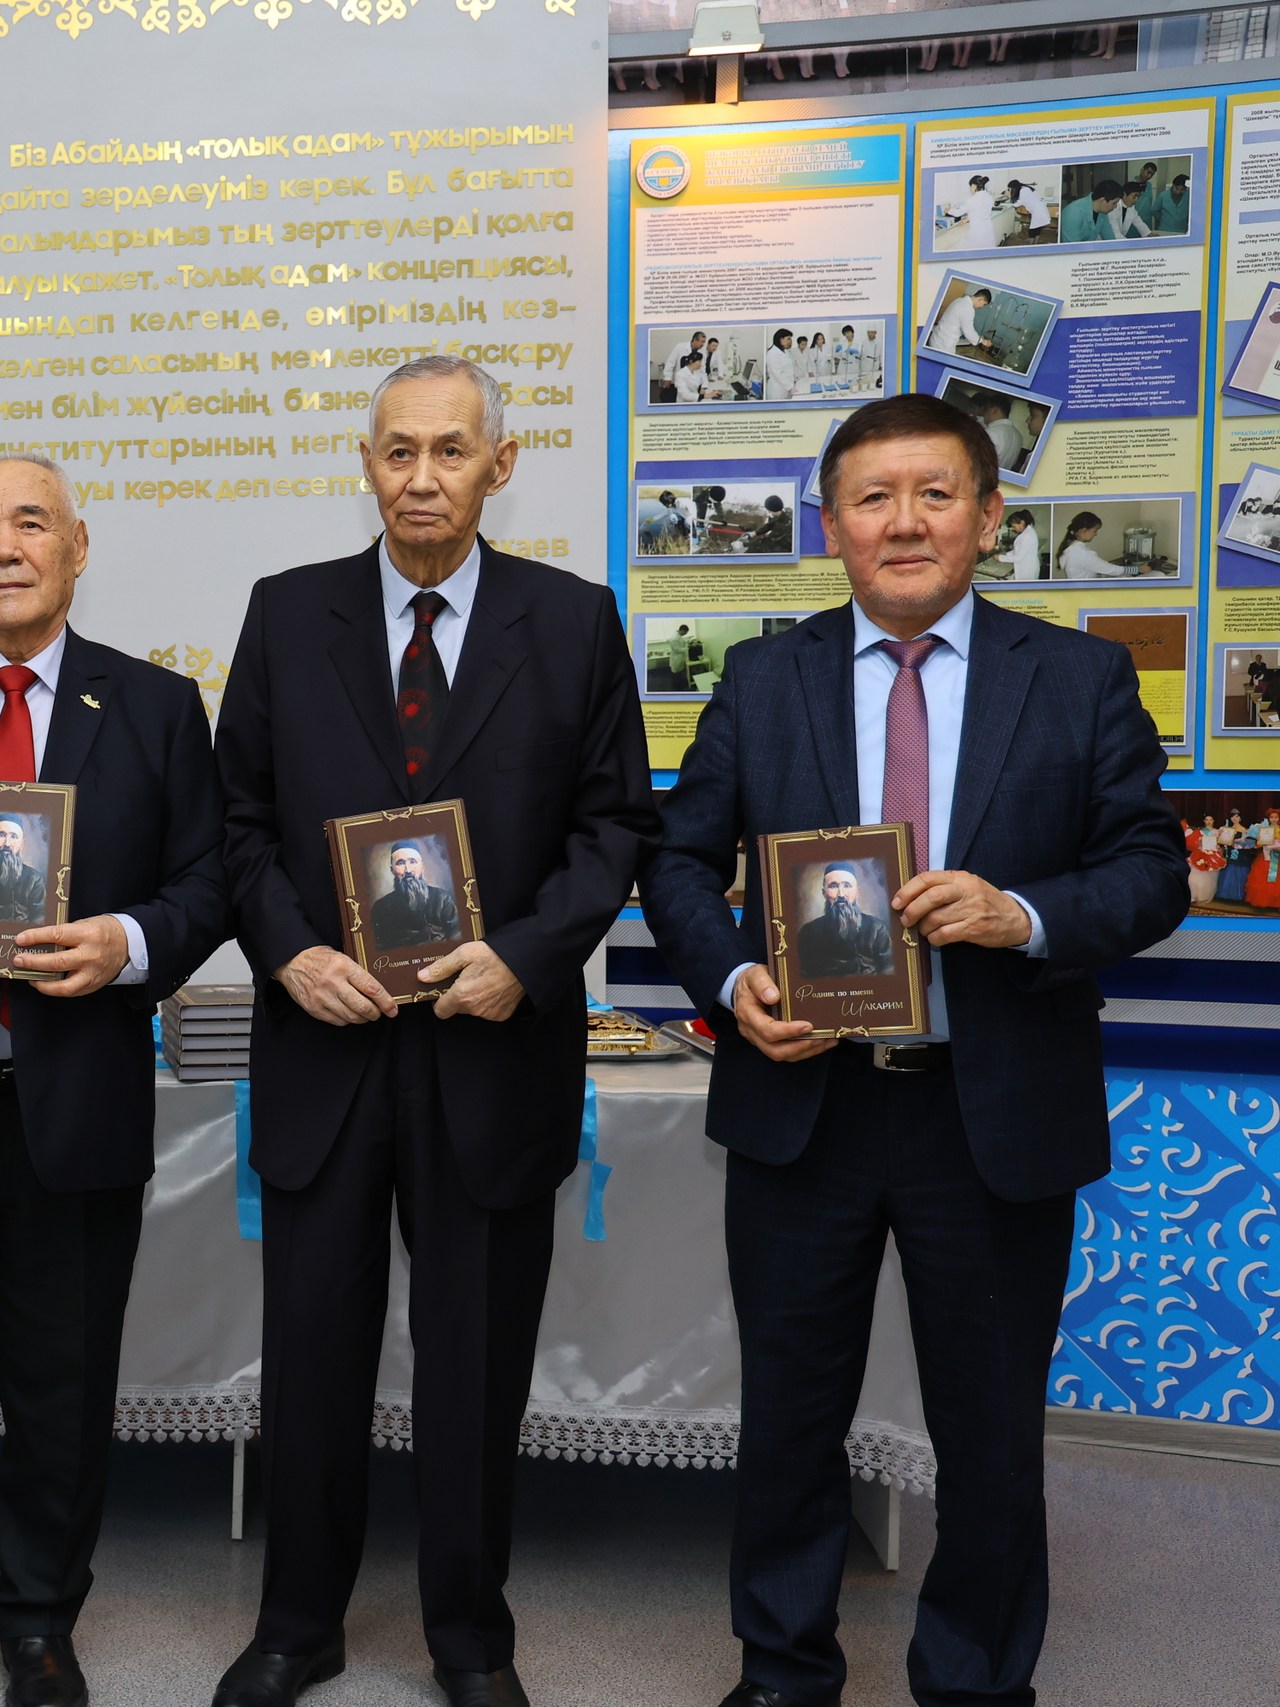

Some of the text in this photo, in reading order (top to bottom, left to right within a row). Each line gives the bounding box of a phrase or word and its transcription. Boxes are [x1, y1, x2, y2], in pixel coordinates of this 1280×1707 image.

[9, 123, 574, 168] Біз Абайдың «толық адам» тұжырымын
[80, 174, 268, 214] зерделеуіміз
[280, 175, 375, 204] керек.
[387, 170, 436, 201] Бұл
[447, 167, 573, 192] бағытта
[218, 223, 274, 246] тың
[280, 208, 480, 248] зерттеулерді
[487, 210, 574, 238] қолға
[62, 270, 159, 296] қажет.
[164, 264, 266, 289] «Толық
[271, 263, 362, 288] адам»
[368, 254, 573, 282] концепциясы,
[130, 309, 288, 331] келгенде,
[305, 296, 487, 332] өміріміздің
[90, 352, 260, 374] саласының
[272, 338, 438, 370] мемлекетті
[443, 338, 574, 370] басқару
[52, 391, 119, 418] білім
[284, 387, 370, 412] бизне
[124, 478, 212, 507] керек
[216, 478, 269, 501] деп
[373, 956, 410, 972] Родник
[795, 984, 834, 1002] Родник
[841, 1000, 903, 1017] ШАКАРИМ
